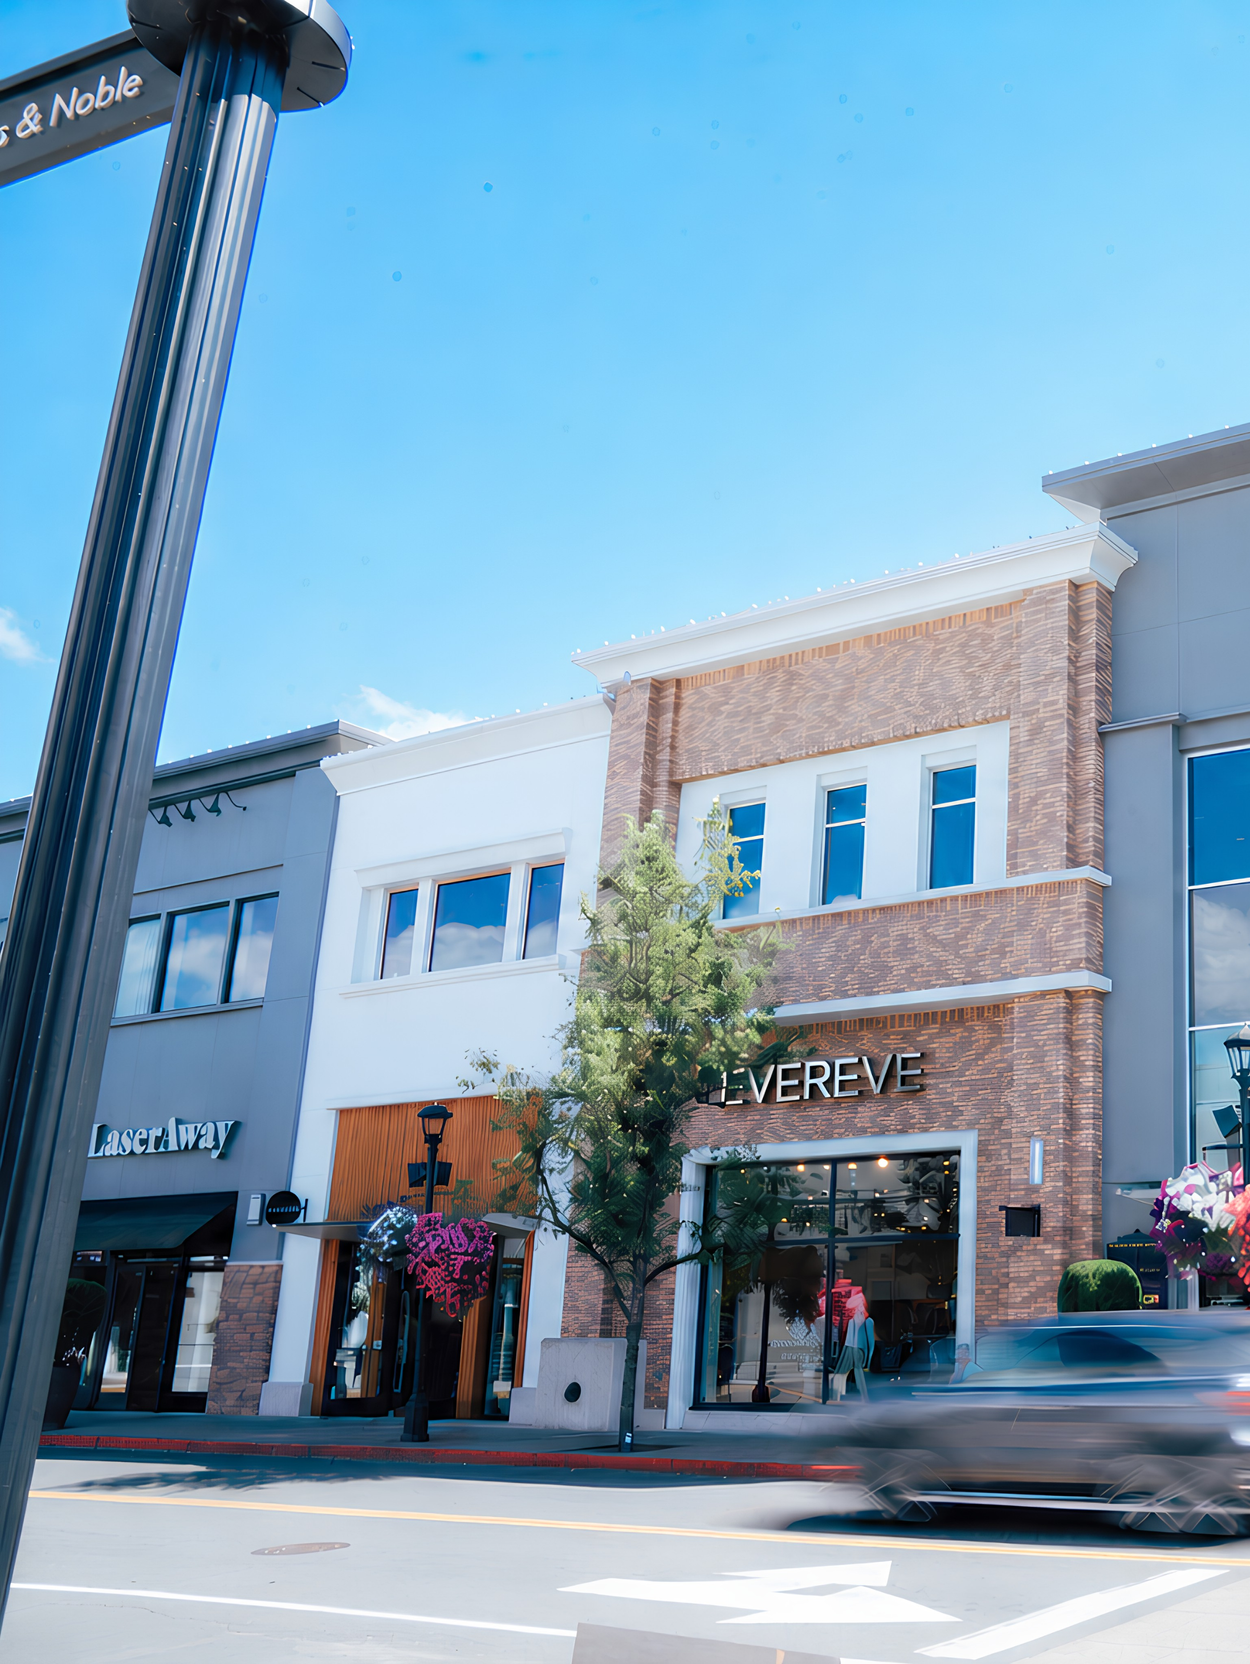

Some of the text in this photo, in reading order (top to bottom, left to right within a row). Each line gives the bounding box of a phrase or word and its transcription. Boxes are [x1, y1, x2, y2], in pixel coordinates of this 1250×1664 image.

[16, 103, 43, 138] &
[49, 66, 143, 127] Noble
[721, 1052, 923, 1105] EVEREVE
[88, 1117, 235, 1159] LaserAway
